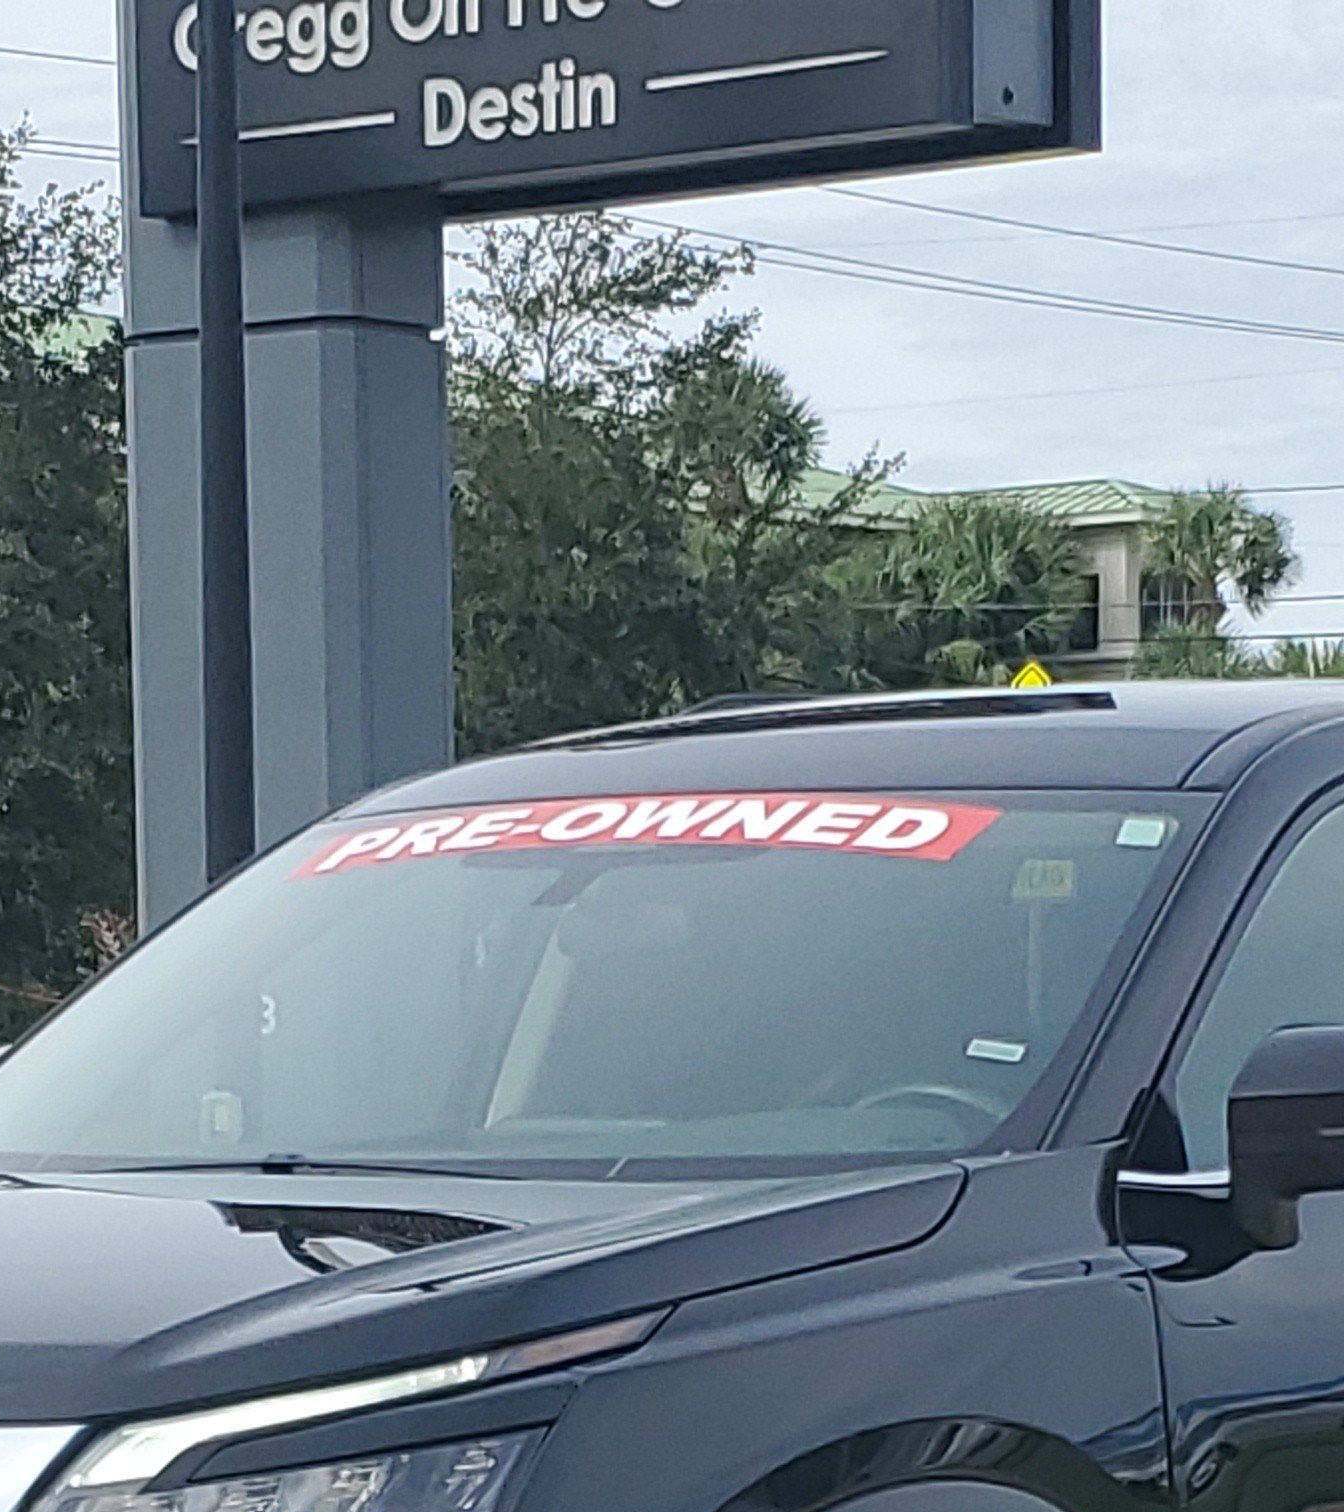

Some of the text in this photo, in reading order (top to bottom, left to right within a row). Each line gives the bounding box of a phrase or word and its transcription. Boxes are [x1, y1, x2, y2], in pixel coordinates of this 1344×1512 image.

[173, 0, 370, 73] egg
[423, 57, 616, 147] Destin
[314, 799, 949, 873] PRE-OWNED
